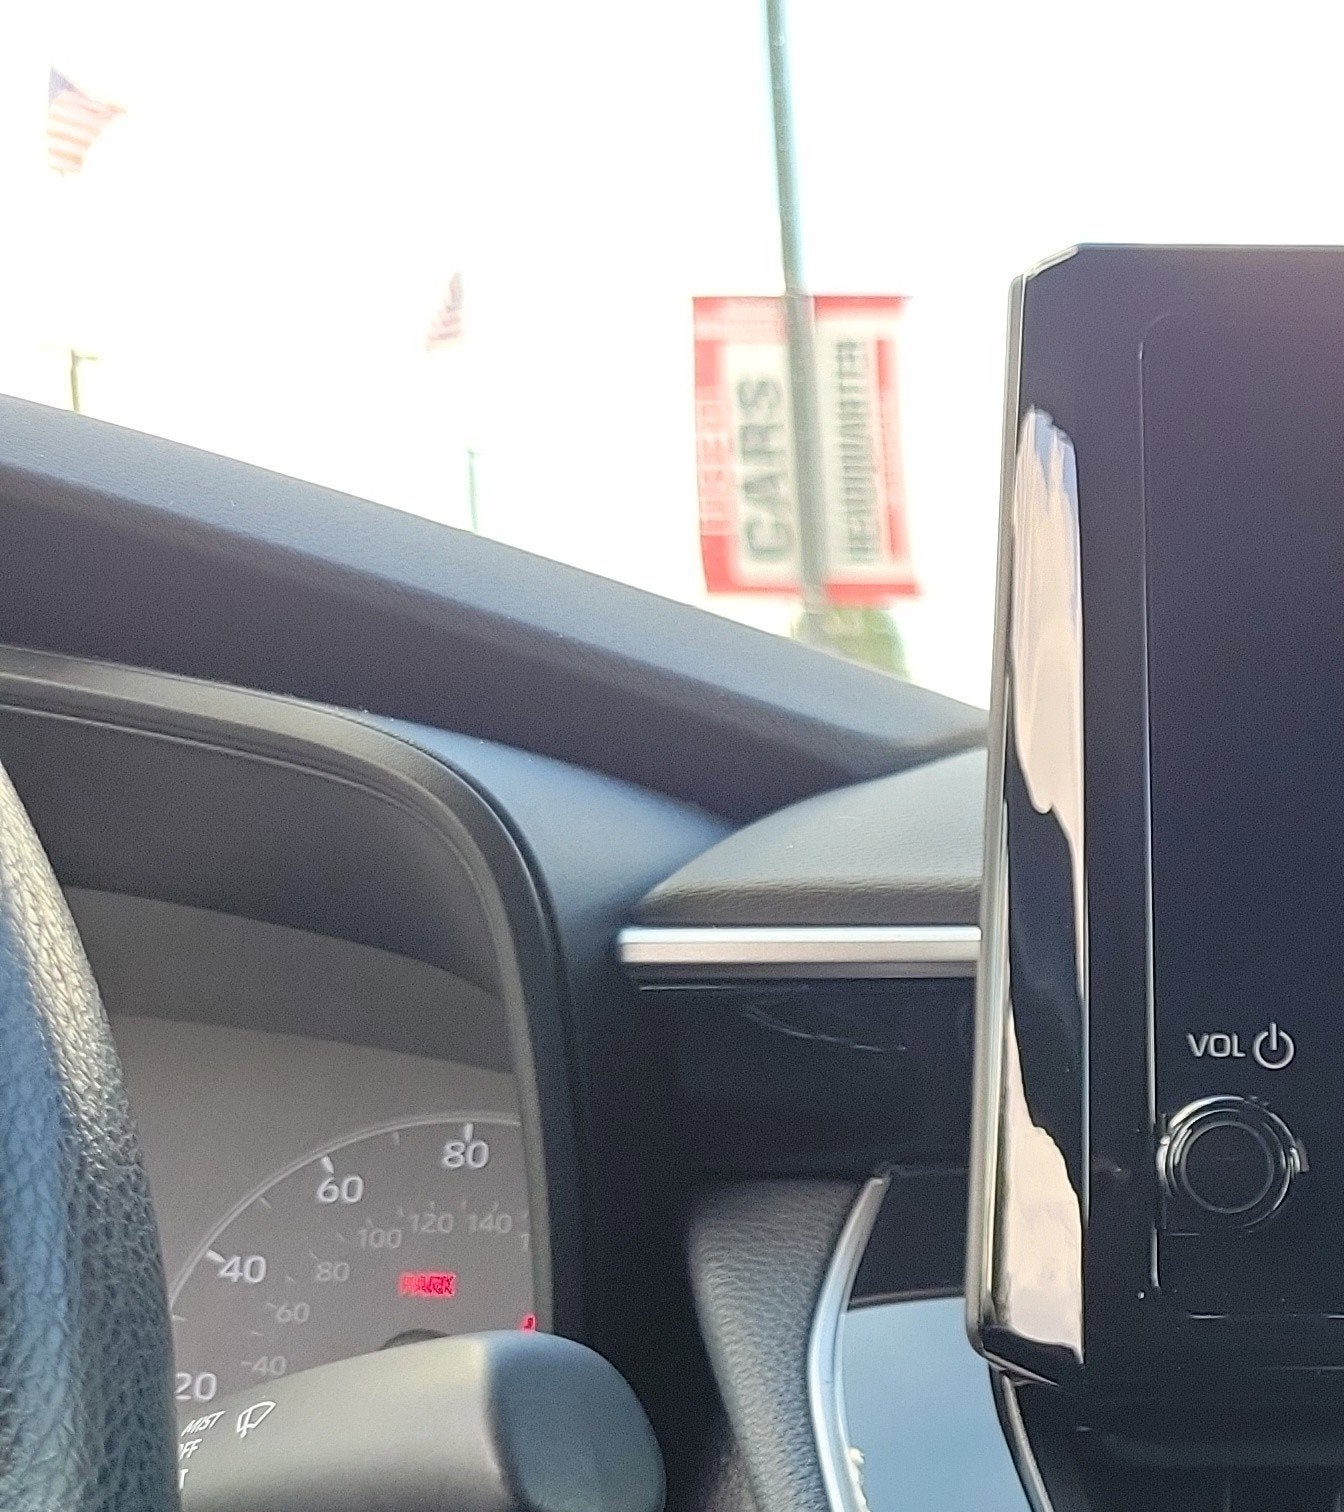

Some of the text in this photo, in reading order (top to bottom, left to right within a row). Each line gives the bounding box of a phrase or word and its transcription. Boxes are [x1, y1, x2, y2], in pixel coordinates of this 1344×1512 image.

[735, 376, 793, 563] CARS
[1187, 1033, 1246, 1058] VOL
[442, 1139, 490, 1169] 80
[316, 1175, 364, 1203] 60
[410, 1213, 513, 1234] 120 140
[359, 1229, 402, 1249] 100
[218, 1255, 267, 1284] 40
[316, 1261, 350, 1283] 80
[276, 1301, 311, 1323] 60
[175, 1371, 218, 1401] 20
[180, 1409, 226, 1437] MIST
[180, 1438, 203, 1460] FF
